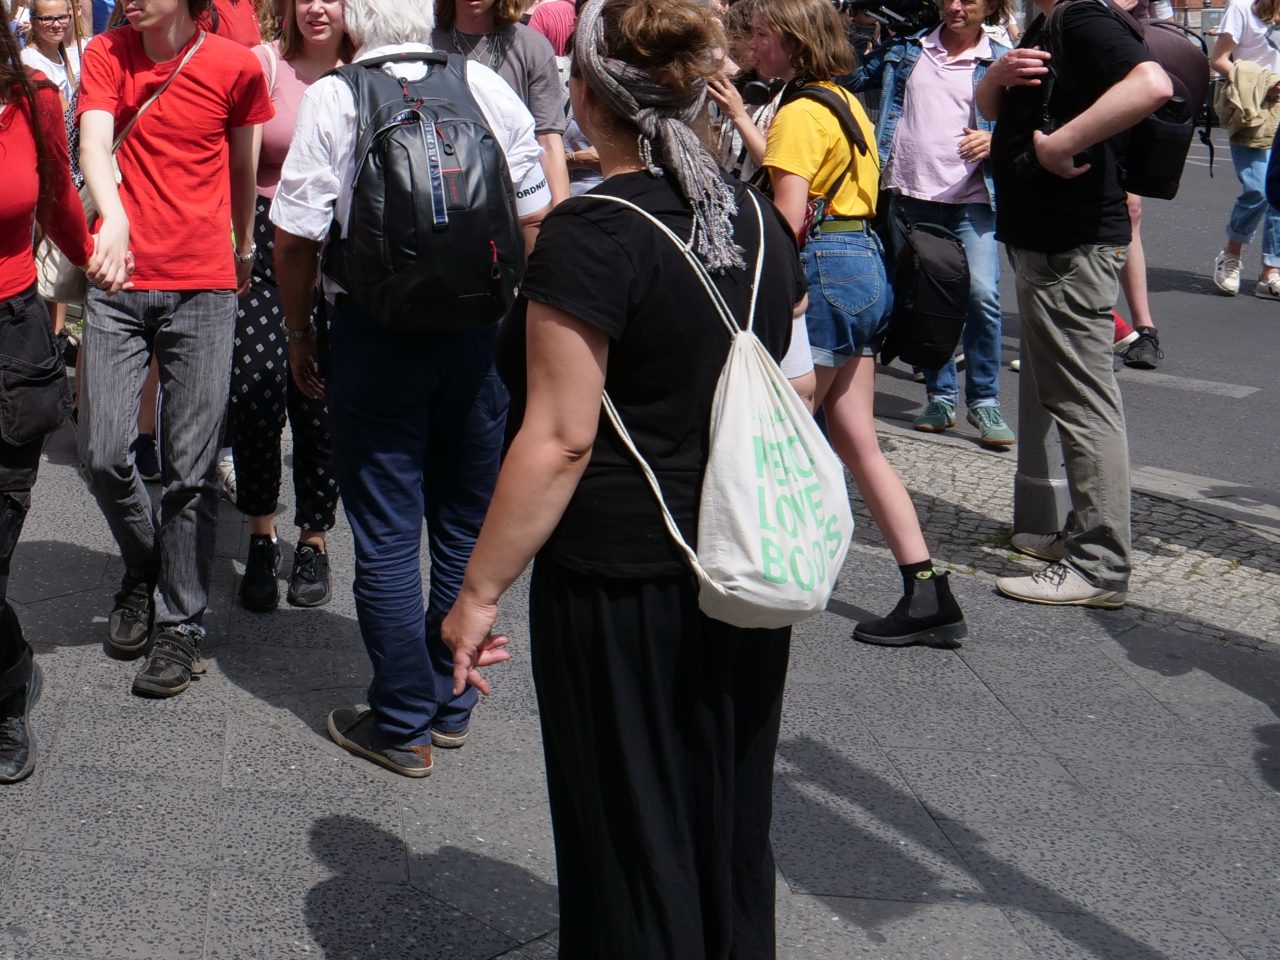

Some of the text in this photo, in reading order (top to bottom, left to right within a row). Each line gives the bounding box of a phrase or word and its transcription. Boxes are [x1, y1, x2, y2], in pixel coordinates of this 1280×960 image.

[516, 178, 546, 199] ORDNE
[752, 435, 815, 487] PEAC
[758, 483, 825, 538] LOVE
[761, 514, 843, 592] BOOS
